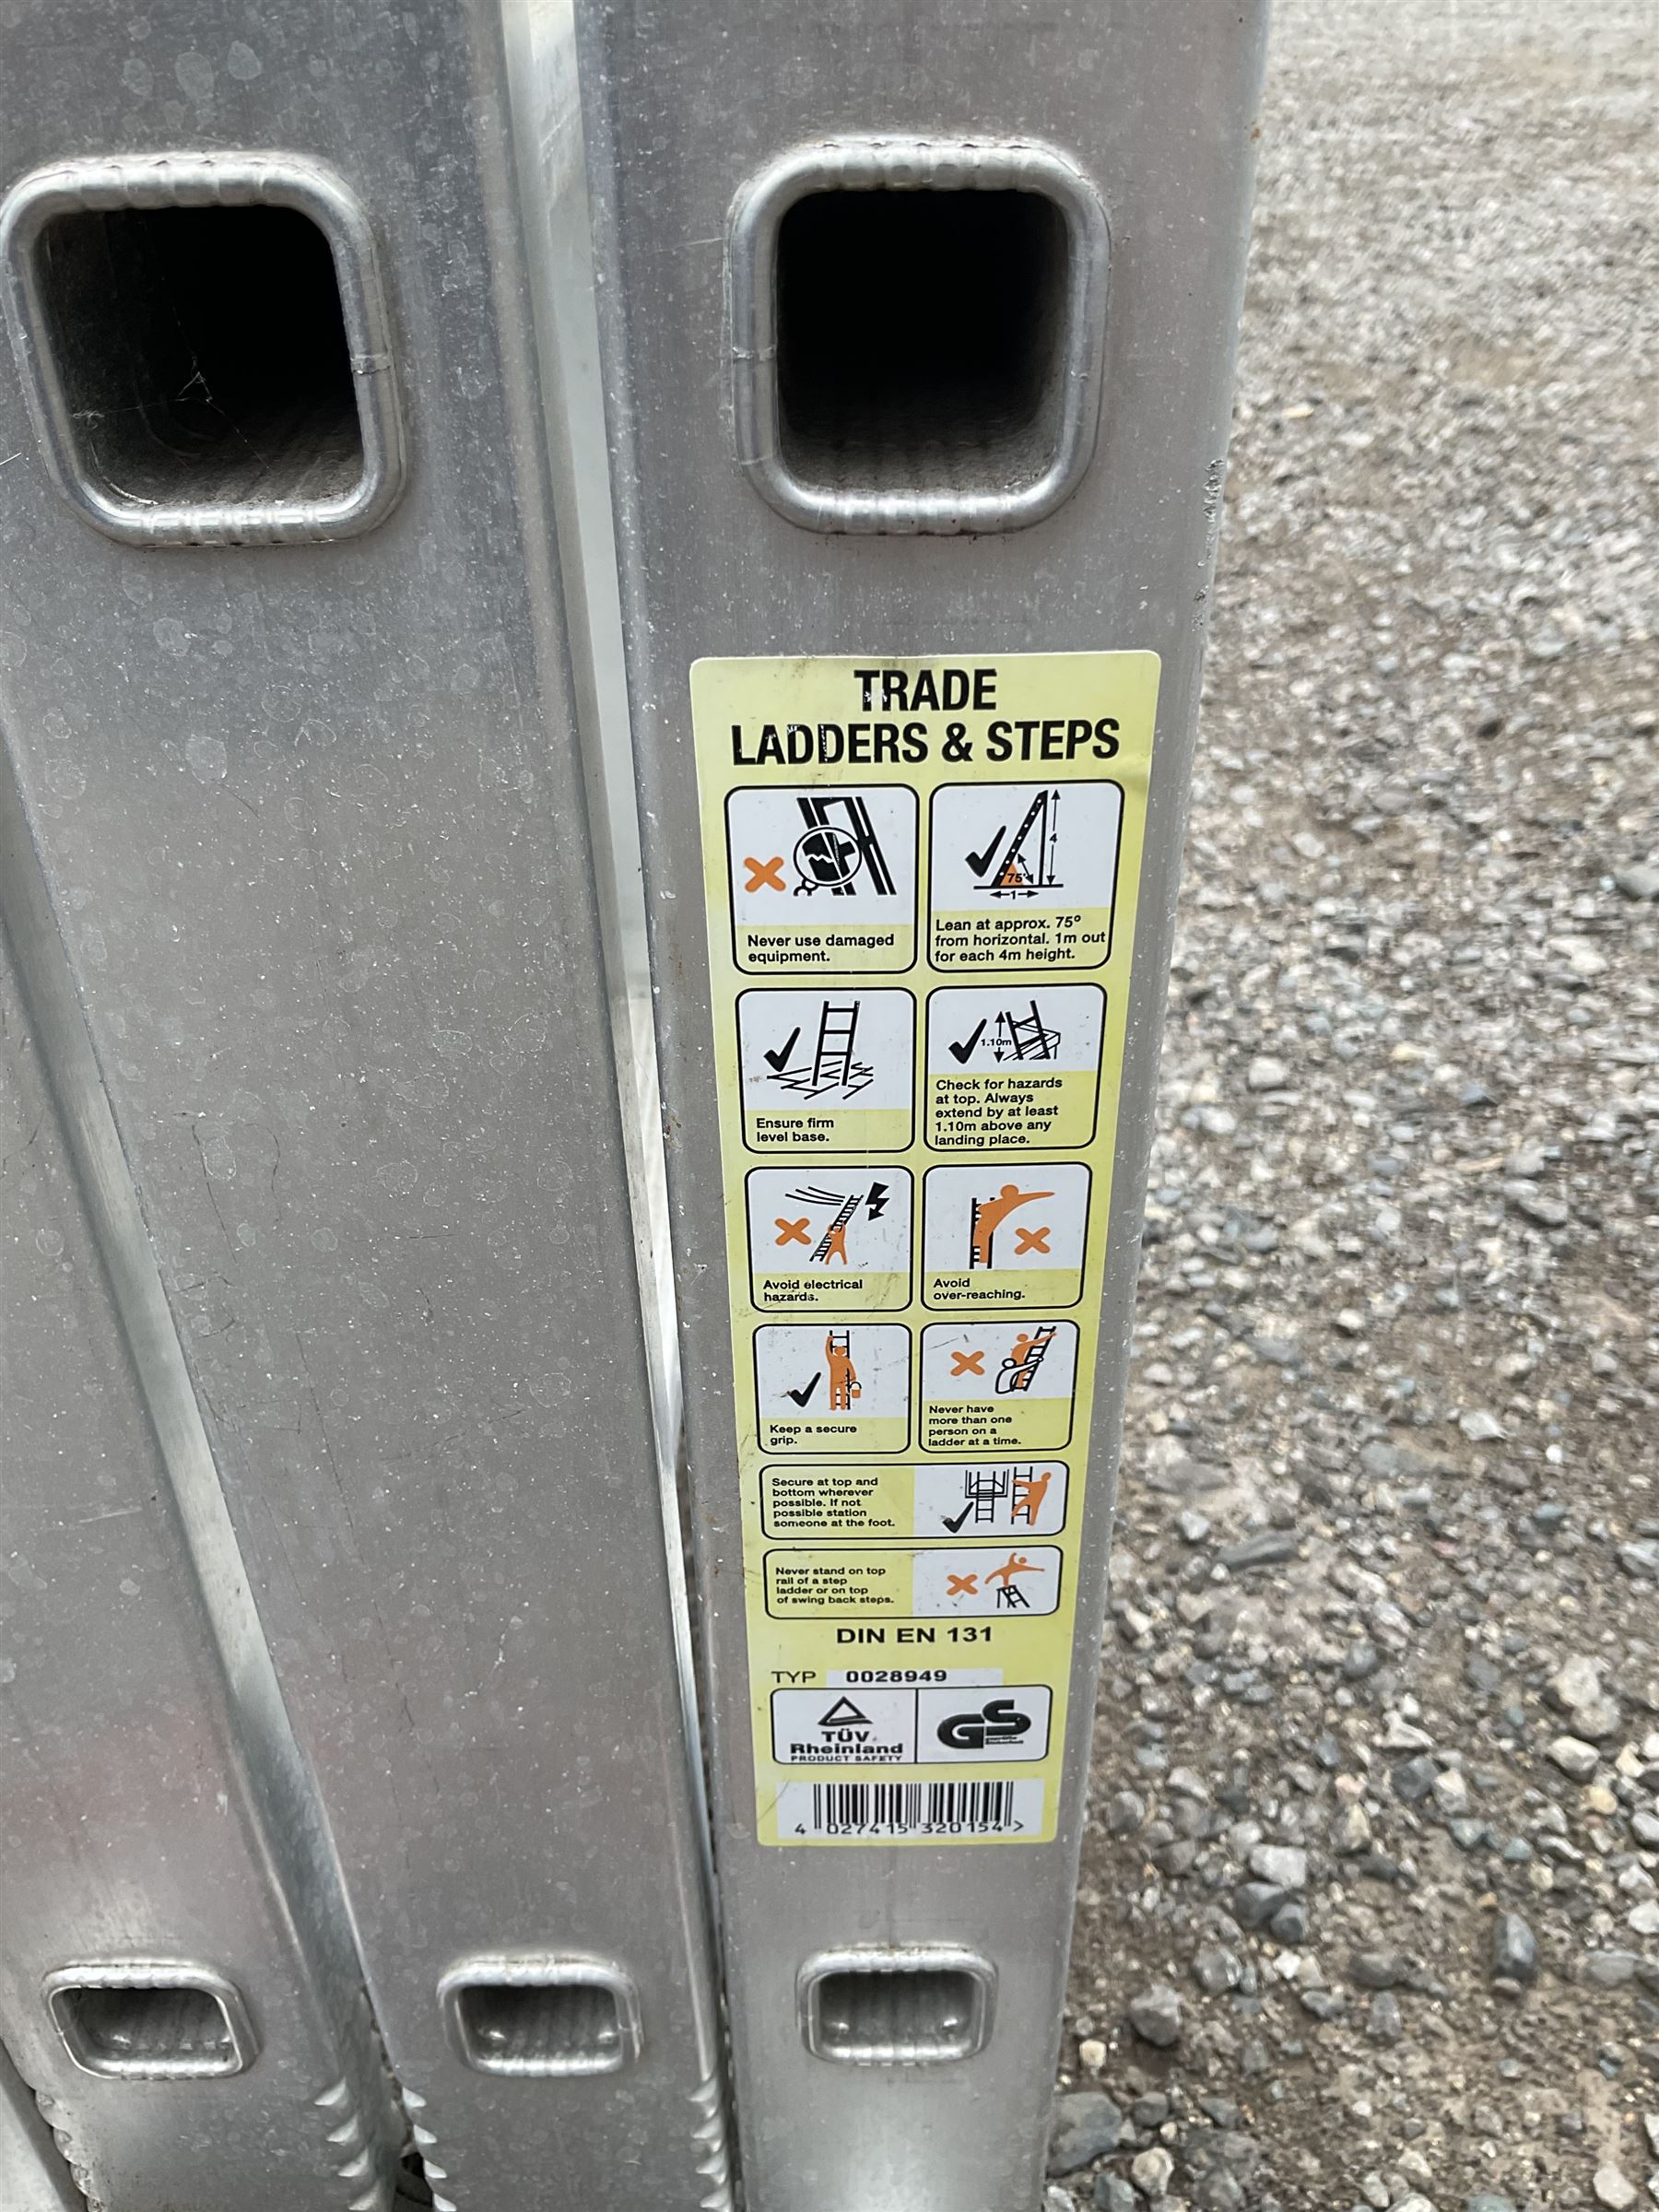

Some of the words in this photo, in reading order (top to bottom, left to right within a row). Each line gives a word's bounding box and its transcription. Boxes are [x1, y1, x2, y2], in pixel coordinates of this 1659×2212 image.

[854, 669, 996, 712] TRADE
[732, 723, 928, 765] LADDERS
[942, 723, 972, 762] &
[987, 718, 1119, 761] STEPS
[1050, 833, 1057, 842] 4
[1011, 890, 1016, 900] 1
[936, 920, 971, 931] Lean
[976, 919, 990, 930] at
[995, 920, 1050, 932] approx.
[748, 935, 791, 947] Never
[795, 937, 820, 946] use
[826, 934, 894, 948] damaged
[935, 935, 968, 947] from
[974, 933, 1049, 946] horizontal.
[1055, 933, 1077, 944] 1m
[1082, 932, 1105, 943] out
[748, 950, 830, 964] equipment.
[935, 951, 955, 961] for
[959, 950, 994, 961] each
[999, 949, 1020, 960] 4m
[1026, 948, 1075, 961] height.
[935, 1079, 980, 1090] Check
[983, 1079, 1005, 1089] for
[1008, 1077, 1062, 1088] hazards
[936, 1095, 948, 1104] at
[953, 1094, 980, 1106] top.
[984, 1093, 1033, 1105] Always
[935, 1107, 982, 1118] extend
[987, 1107, 1004, 1119] by
[1008, 1107, 1020, 1116] at
[1026, 1106, 1058, 1115] least
[757, 1118, 803, 1128] Ensure
[807, 1118, 833, 1127] firm
[935, 1122, 976, 1132] 1.10m
[981, 1121, 1022, 1131] above
[1027, 1122, 1052, 1132] any
[758, 1132, 787, 1142] level
[793, 1132, 829, 1141] base.
[935, 1135, 984, 1147] landing
[989, 1135, 1030, 1147] place.
[763, 1280, 799, 1289] Avoid
[804, 1279, 862, 1288] electrical
[934, 1278, 970, 1288] Avoid
[764, 1292, 818, 1302] hazards.
[934, 1289, 1025, 1300] over-reaching.
[771, 1425, 801, 1434] Keep
[771, 1436, 797, 1445] grip.
[832, 1478, 852, 1487] top
[773, 1499, 826, 1508] possible.
[773, 1509, 823, 1518] possible
[776, 1567, 809, 1575] Never
[813, 1567, 845, 1575] stand
[866, 1567, 886, 1576] top
[822, 1577, 848, 1585] step
[777, 1586, 813, 1594] ladder
[850, 1586, 868, 1595] top
[792, 1596, 825, 1605] swing
[829, 1595, 856, 1604] back
[860, 1596, 895, 1605] steps.
[838, 1629, 884, 1643] DIN
[898, 1628, 935, 1642] EN
[947, 1627, 992, 1642] 131
[771, 1671, 816, 1683] TYP
[847, 1670, 947, 1682] 0028949
[822, 1728, 869, 1742] TÜV
[791, 1744, 902, 1753] Rheinland
[795, 1824, 806, 1834] 4
